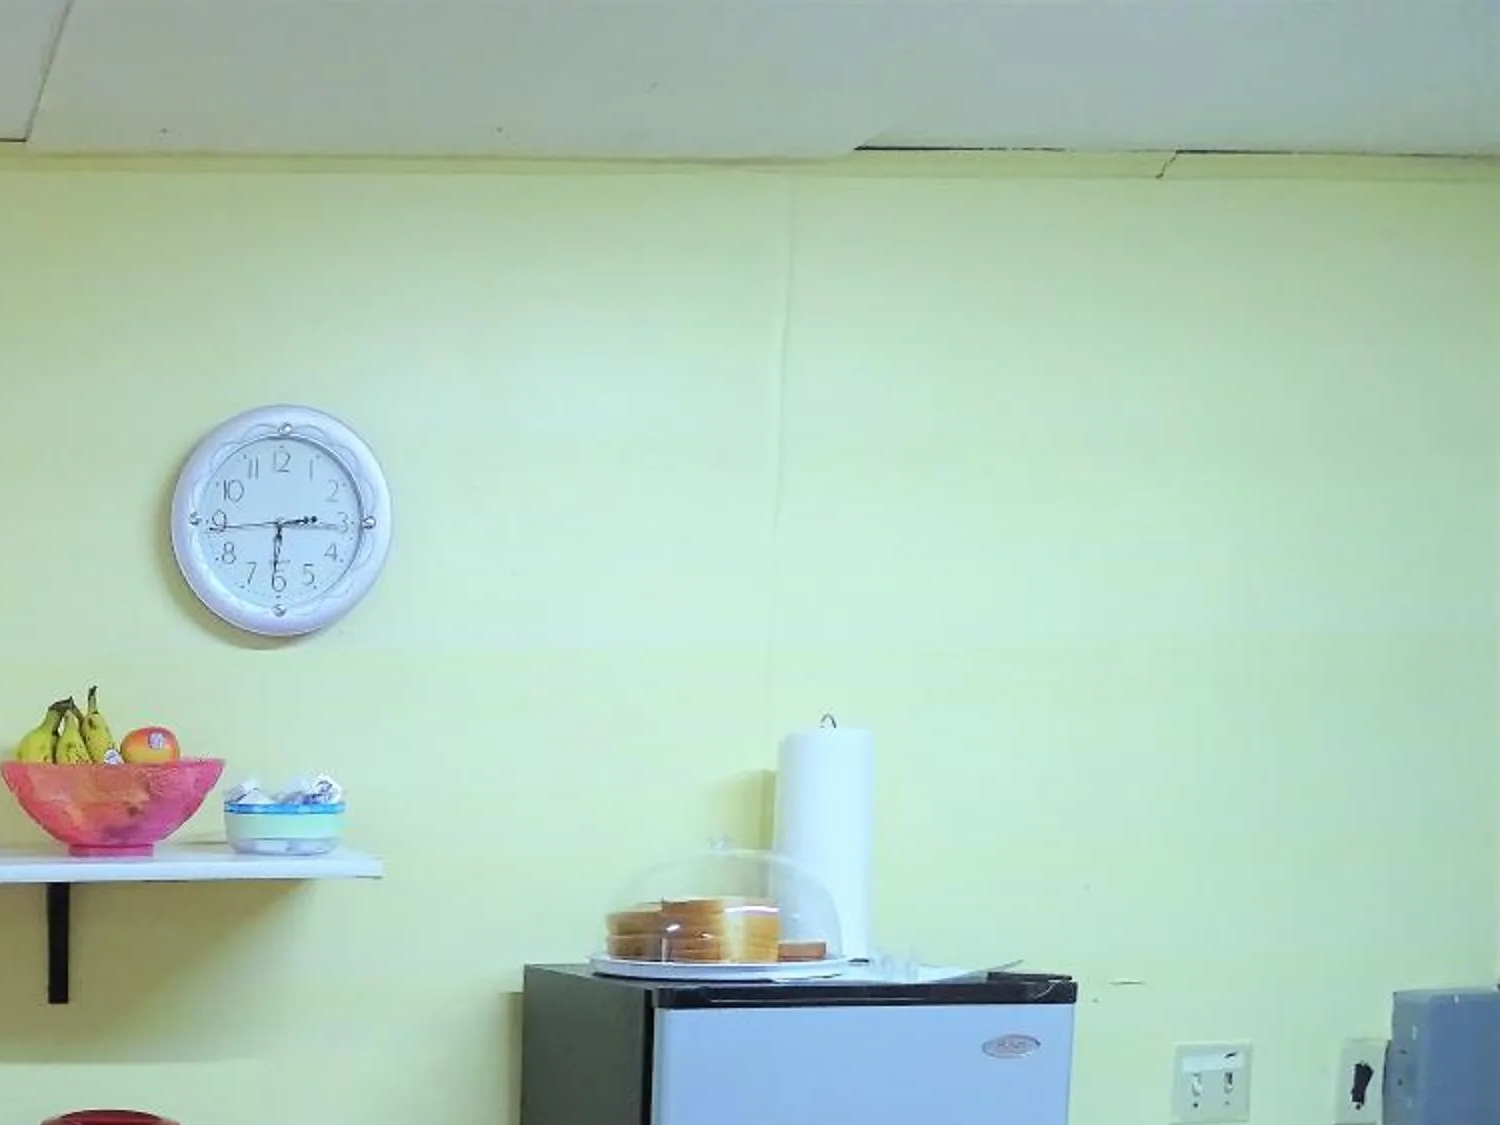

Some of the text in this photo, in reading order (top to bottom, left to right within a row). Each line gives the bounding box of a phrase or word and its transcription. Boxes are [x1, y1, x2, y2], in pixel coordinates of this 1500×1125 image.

[247, 456, 259, 480] 11
[273, 451, 291, 473] 12
[222, 479, 244, 502] 10
[325, 480, 340, 502] 2
[211, 509, 227, 532] 9
[337, 511, 350, 534] 3
[221, 542, 237, 565] 8
[323, 542, 338, 561] 4
[245, 561, 257, 585] 7
[271, 570, 287, 593] 6
[302, 563, 316, 586] 5
